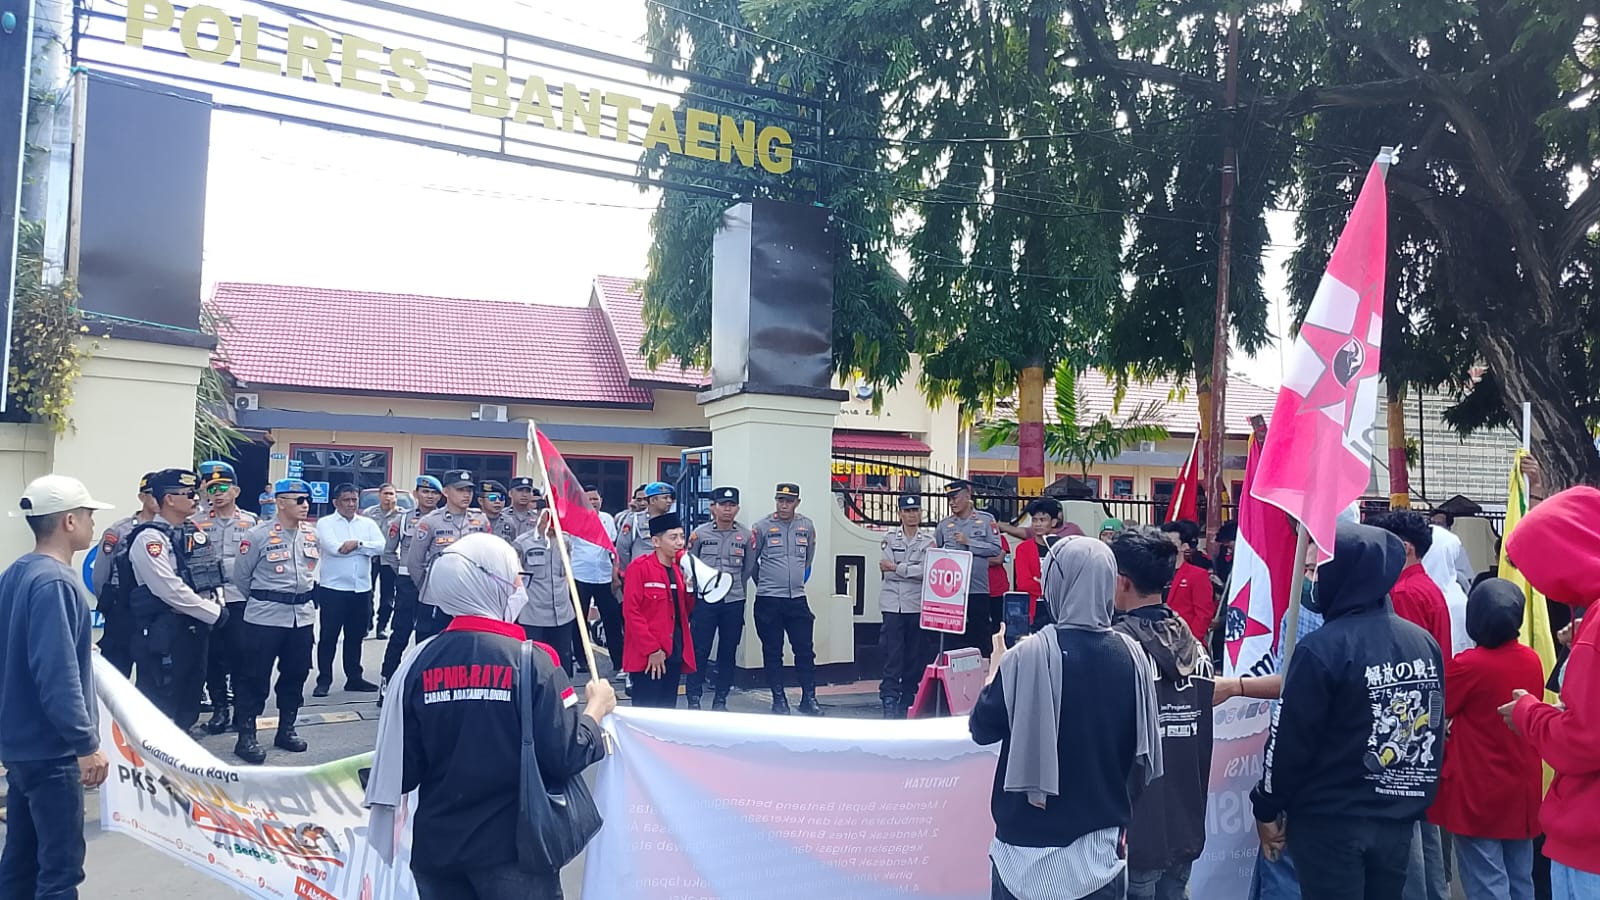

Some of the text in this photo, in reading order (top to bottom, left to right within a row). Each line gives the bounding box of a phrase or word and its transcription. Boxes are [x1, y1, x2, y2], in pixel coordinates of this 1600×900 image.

[125, 0, 793, 175] POLRES BANTAENG
[930, 568, 962, 587] STOP
[118, 764, 157, 795] PKS
[206, 767, 239, 784] Raya
